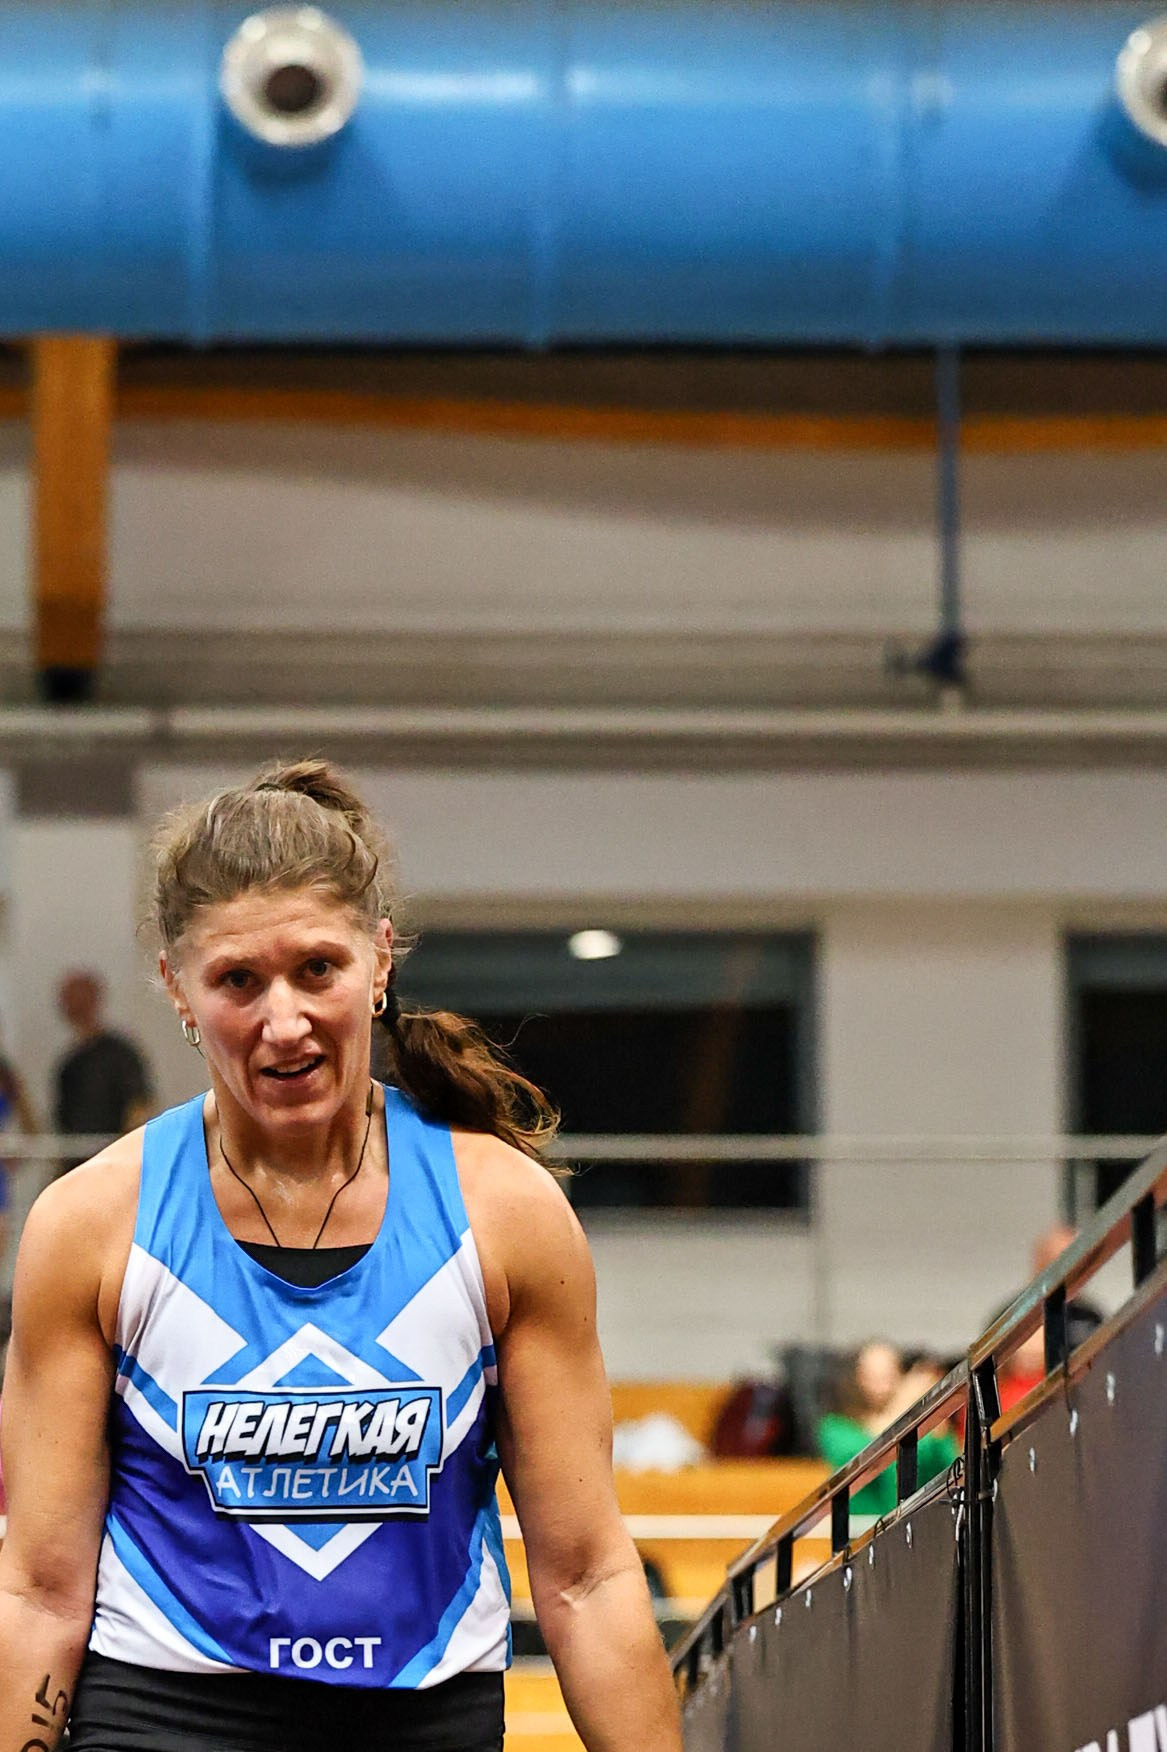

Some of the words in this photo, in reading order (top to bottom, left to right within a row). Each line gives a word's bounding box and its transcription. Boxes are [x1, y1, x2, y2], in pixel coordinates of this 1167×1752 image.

[195, 1397, 433, 1461] НЕЛЕГКАЯ
[215, 1465, 419, 1499] АТЛЕТИКА
[269, 1636, 382, 1669] ГОСТ
